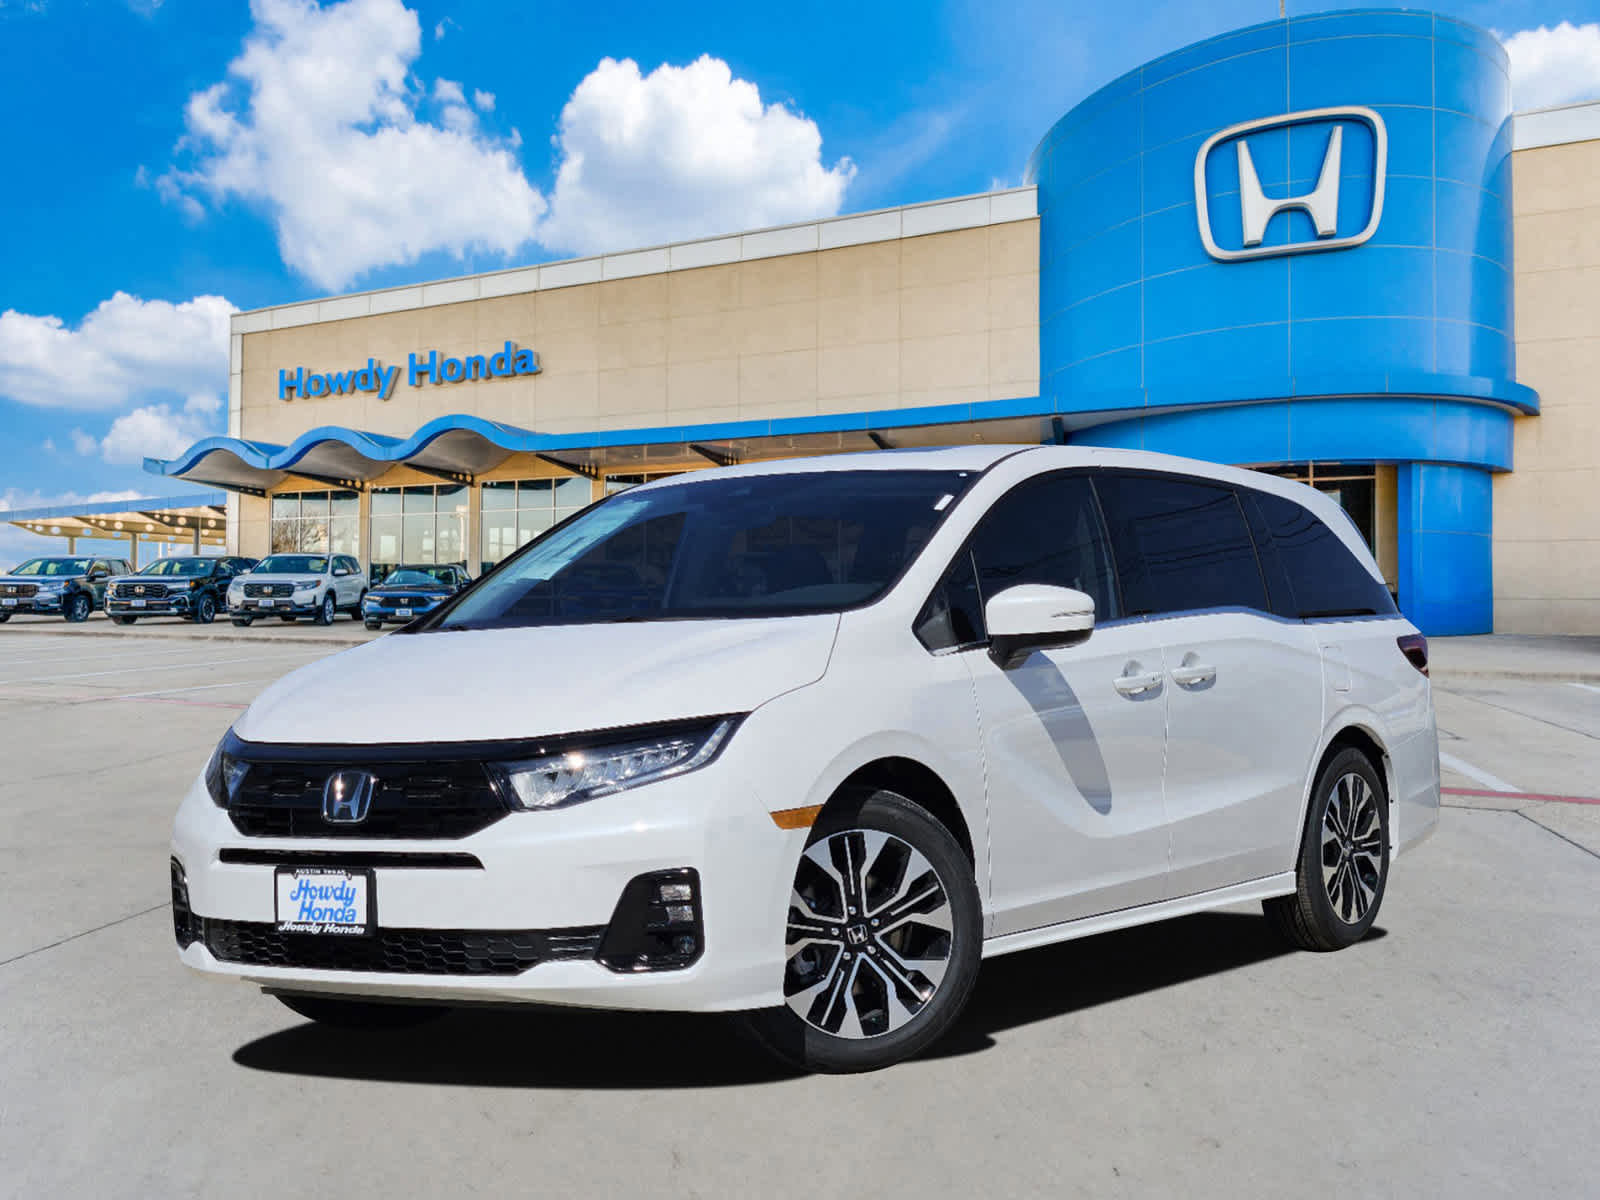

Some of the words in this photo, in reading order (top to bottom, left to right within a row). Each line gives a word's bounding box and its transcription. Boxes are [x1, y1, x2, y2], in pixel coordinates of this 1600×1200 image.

[279, 358, 398, 401] Howdy
[407, 340, 540, 388] Honda
[289, 878, 357, 907] Howdy
[297, 900, 357, 922] Honda
[278, 921, 322, 935] Howdy
[323, 923, 365, 935] Honda
